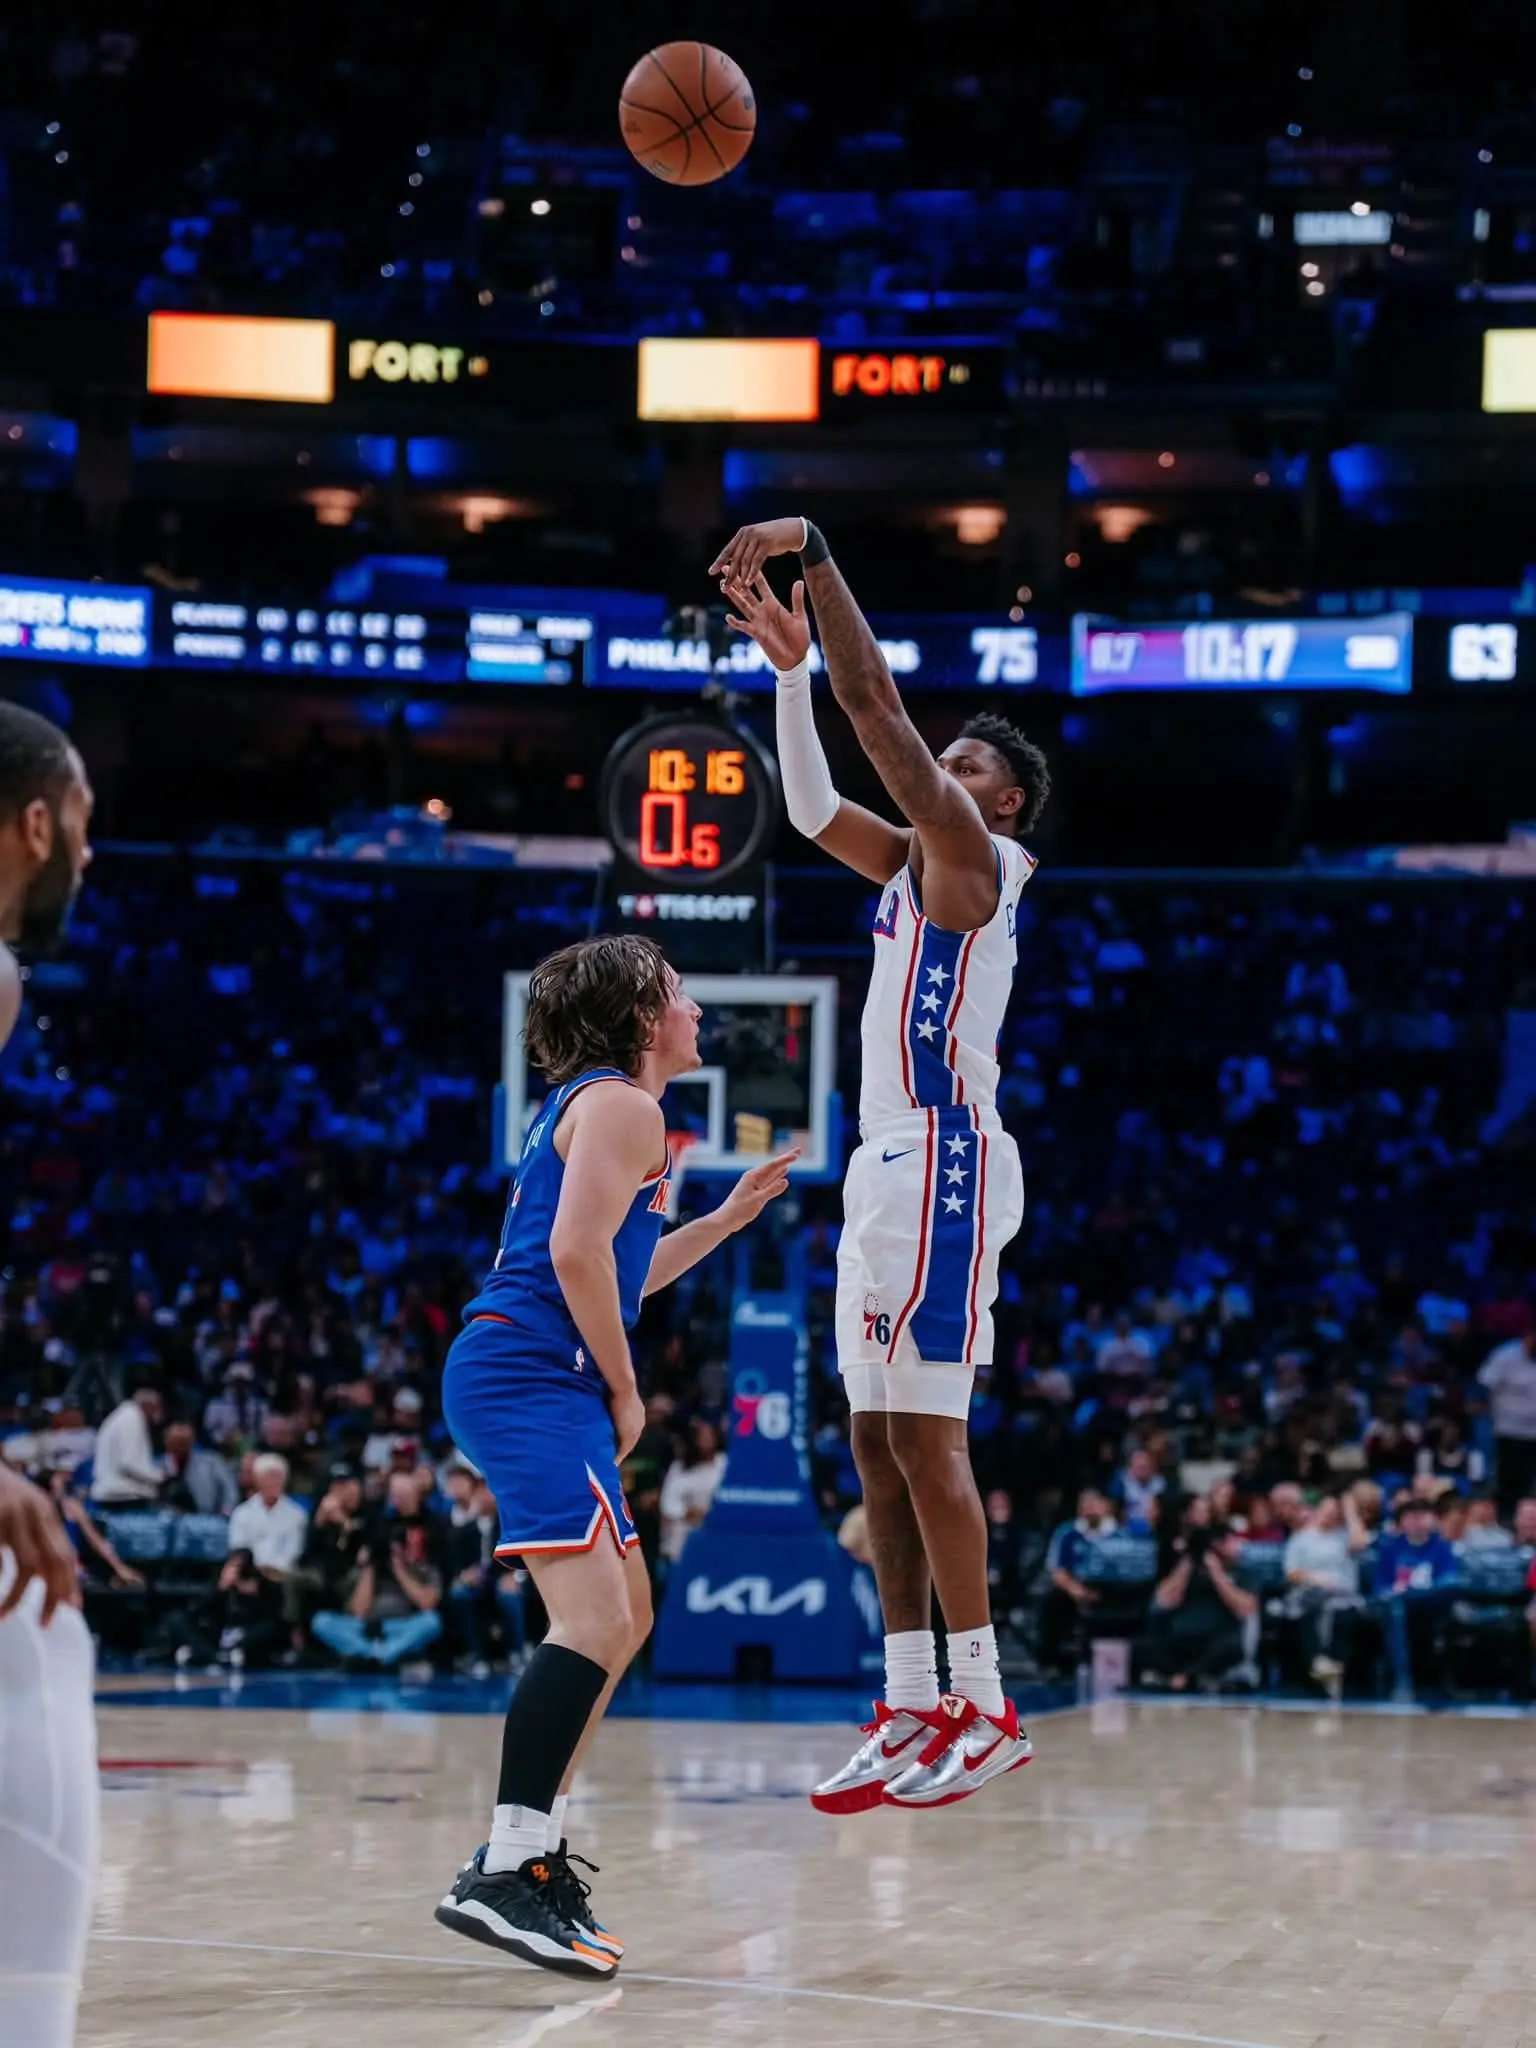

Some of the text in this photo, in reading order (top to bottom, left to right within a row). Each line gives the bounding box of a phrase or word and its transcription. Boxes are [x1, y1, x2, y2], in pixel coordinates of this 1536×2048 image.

[349, 339, 464, 383] FORT
[832, 353, 946, 396] FORT
[971, 627, 1038, 684] 75
[1182, 622, 1298, 682] 10:17
[863, 1309, 891, 1346] 76
[734, 1391, 791, 1440] 76
[686, 1575, 827, 1616] KIA
